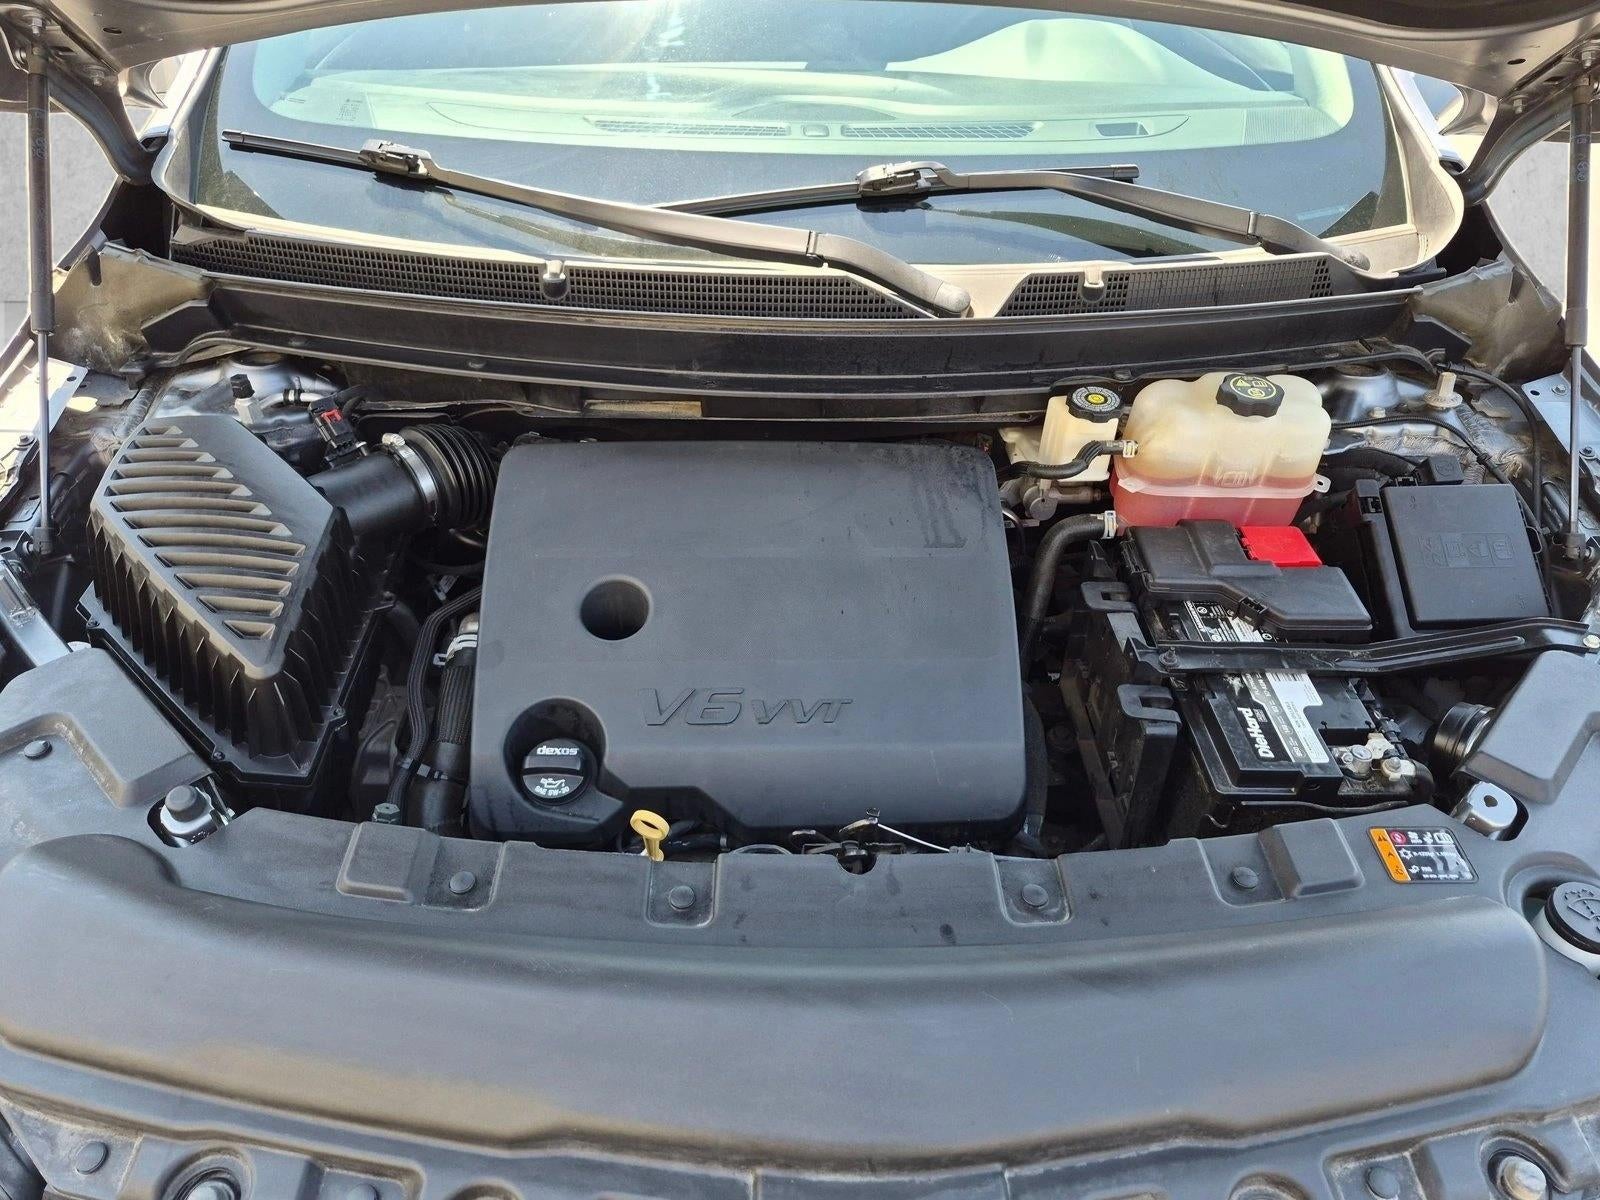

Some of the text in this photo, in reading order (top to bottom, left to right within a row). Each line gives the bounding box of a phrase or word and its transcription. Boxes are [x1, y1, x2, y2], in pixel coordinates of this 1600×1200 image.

[638, 688, 853, 726] V6 VVT
[537, 746, 579, 756] dexos
[1237, 707, 1275, 758] DieHard
